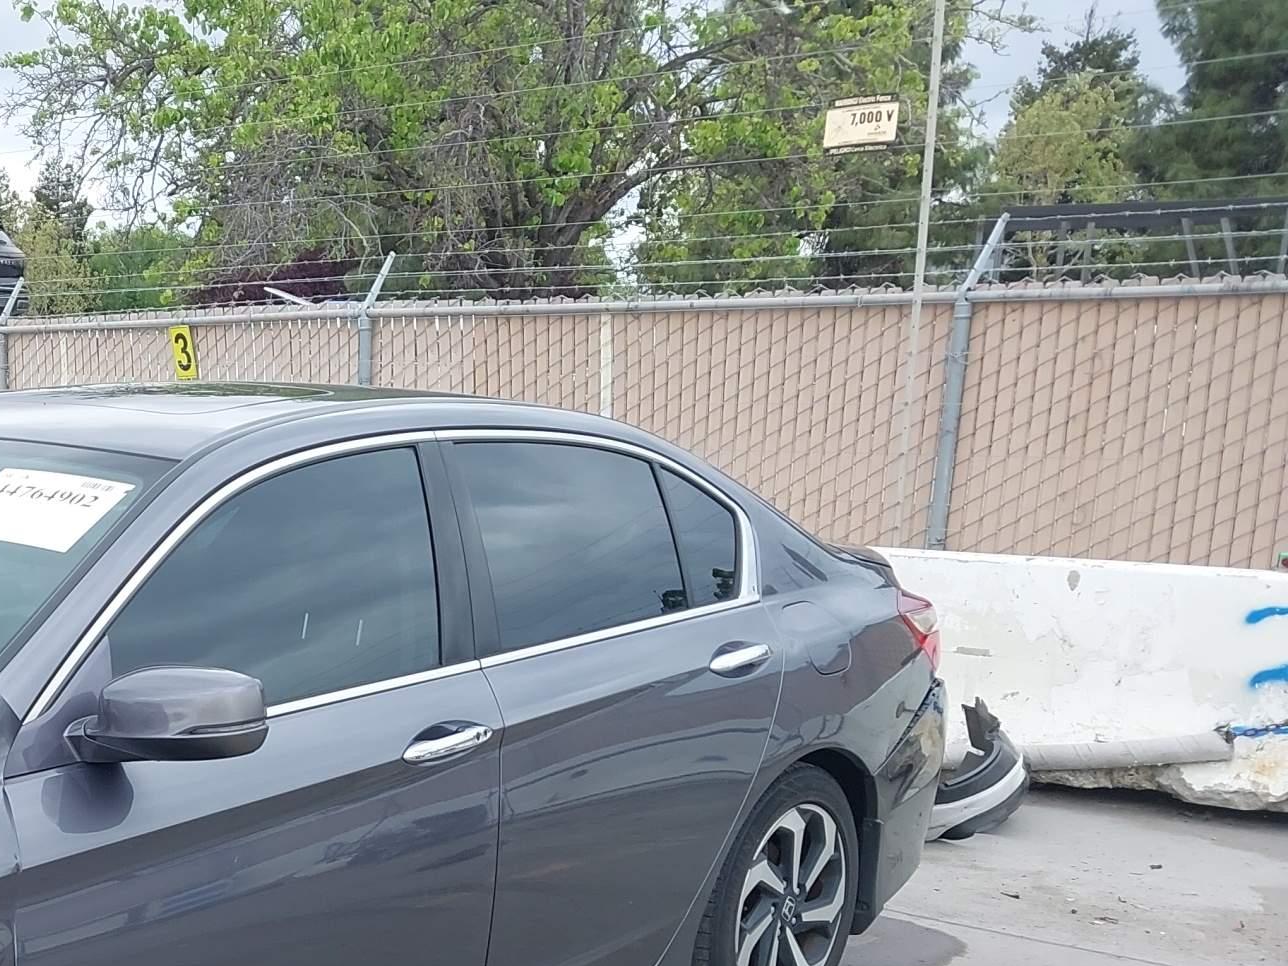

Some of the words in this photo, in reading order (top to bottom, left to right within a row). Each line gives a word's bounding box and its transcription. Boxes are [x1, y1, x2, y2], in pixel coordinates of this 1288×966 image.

[850, 110, 882, 126] 7,000
[886, 109, 894, 122] V
[174, 332, 192, 371] 3
